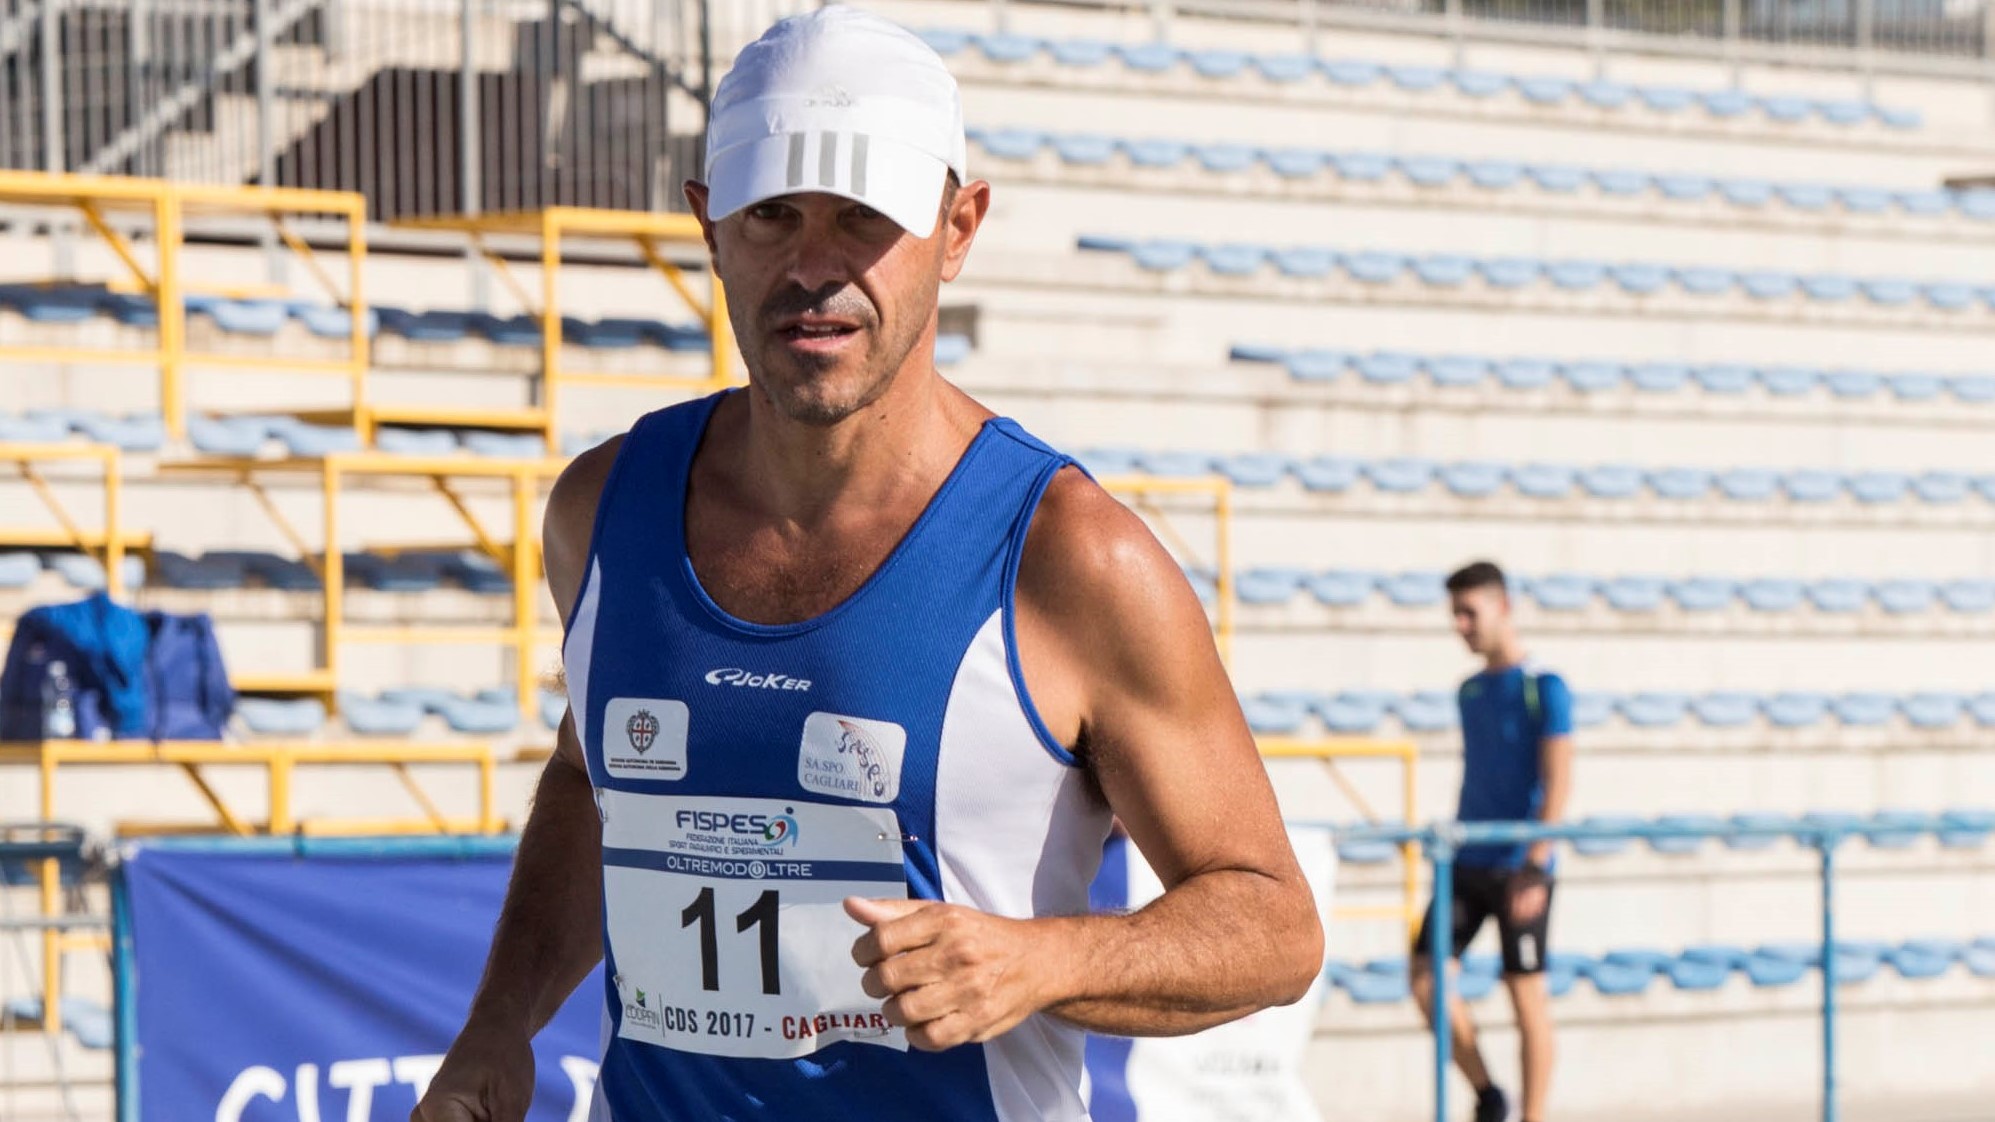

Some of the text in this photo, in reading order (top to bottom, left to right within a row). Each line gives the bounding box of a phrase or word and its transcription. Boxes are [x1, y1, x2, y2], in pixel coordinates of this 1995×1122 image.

[804, 773, 859, 792] CAGLIARI
[676, 810, 767, 834] FISPES
[728, 837, 759, 846] ITALIANA
[682, 886, 781, 995] 11
[665, 1006, 699, 1034] CDS
[707, 1011, 755, 1038] 2017
[782, 1013, 894, 1040] CAGLIAR
